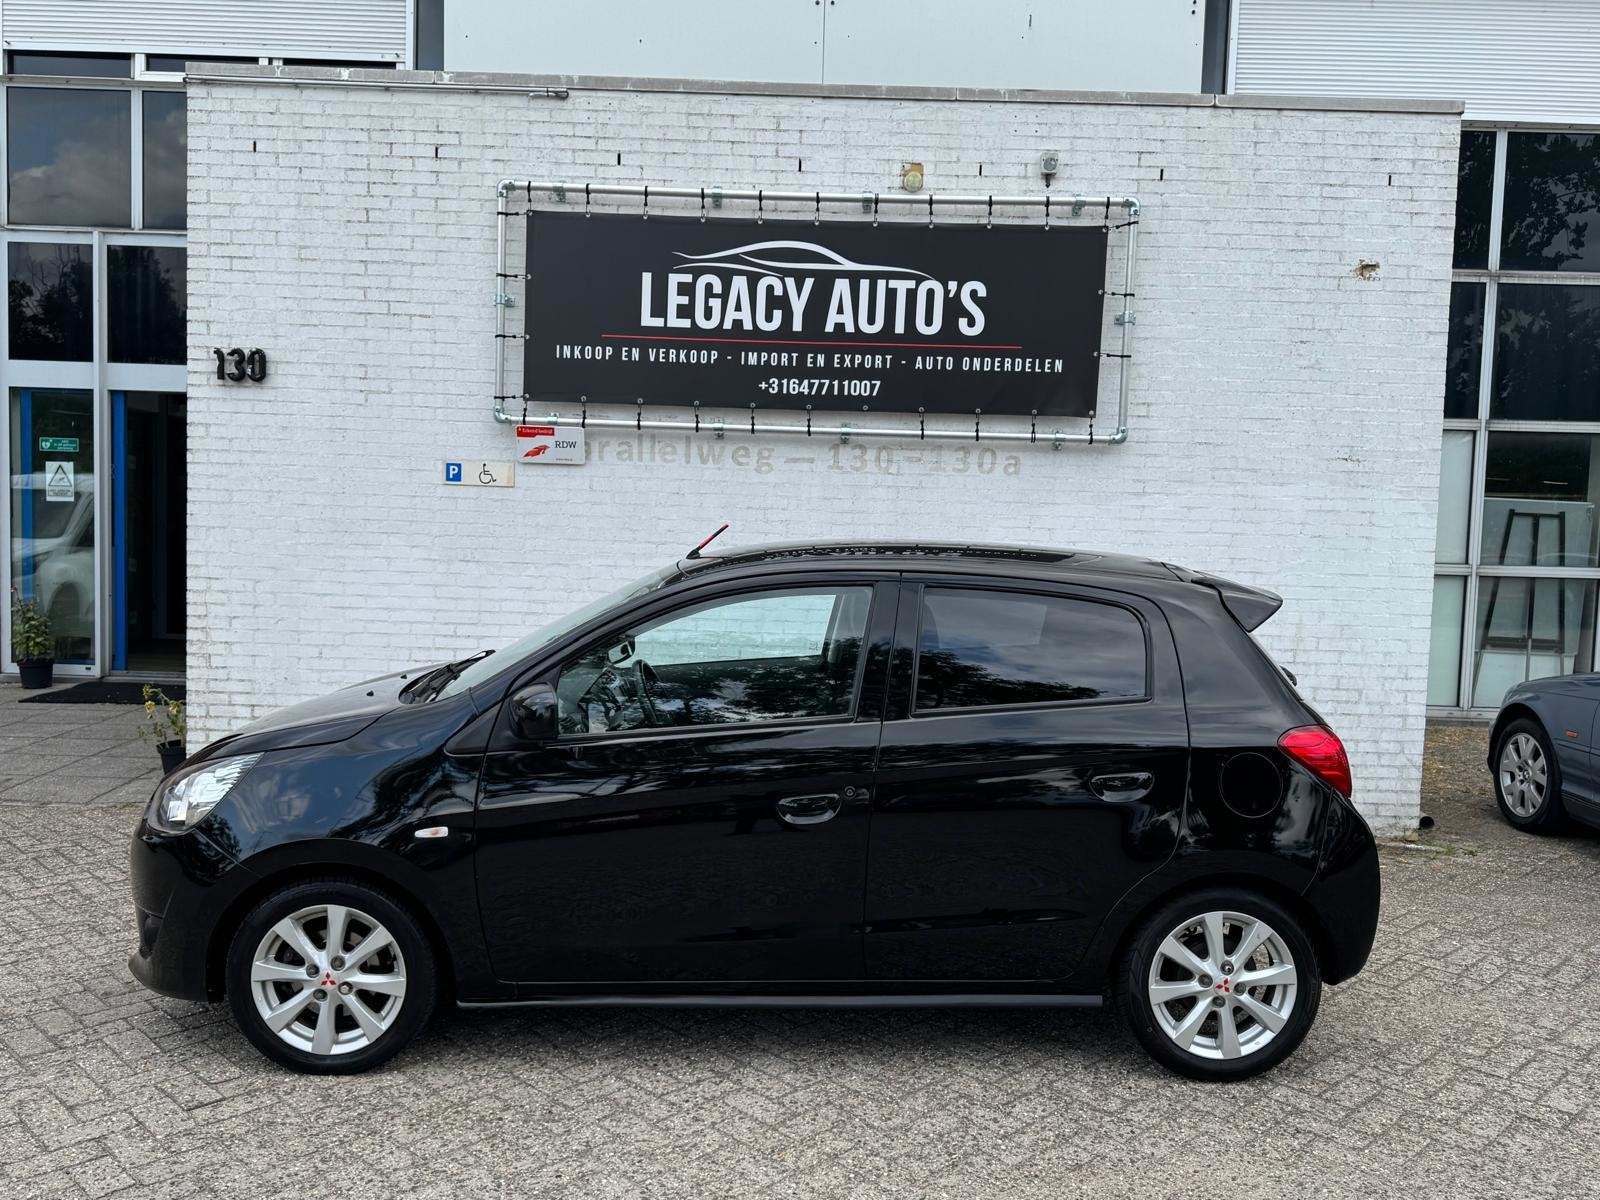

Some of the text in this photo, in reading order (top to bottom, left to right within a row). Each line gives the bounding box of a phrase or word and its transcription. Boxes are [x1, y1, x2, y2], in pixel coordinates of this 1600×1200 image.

[640, 271, 987, 337] LEGACY AUTO'S
[213, 347, 266, 382] 130
[556, 344, 613, 360] INKOOP
[621, 346, 640, 362] EN
[648, 348, 718, 364] VERKOOP
[740, 351, 799, 367] IMPORT
[806, 353, 825, 368] EN
[833, 353, 893, 369] EXPORT
[914, 355, 954, 371] AUTO
[962, 356, 1063, 373] ONDERDELEN
[758, 377, 881, 397] +31647711007
[554, 440, 577, 449] RDW
[449, 465, 459, 479] P
